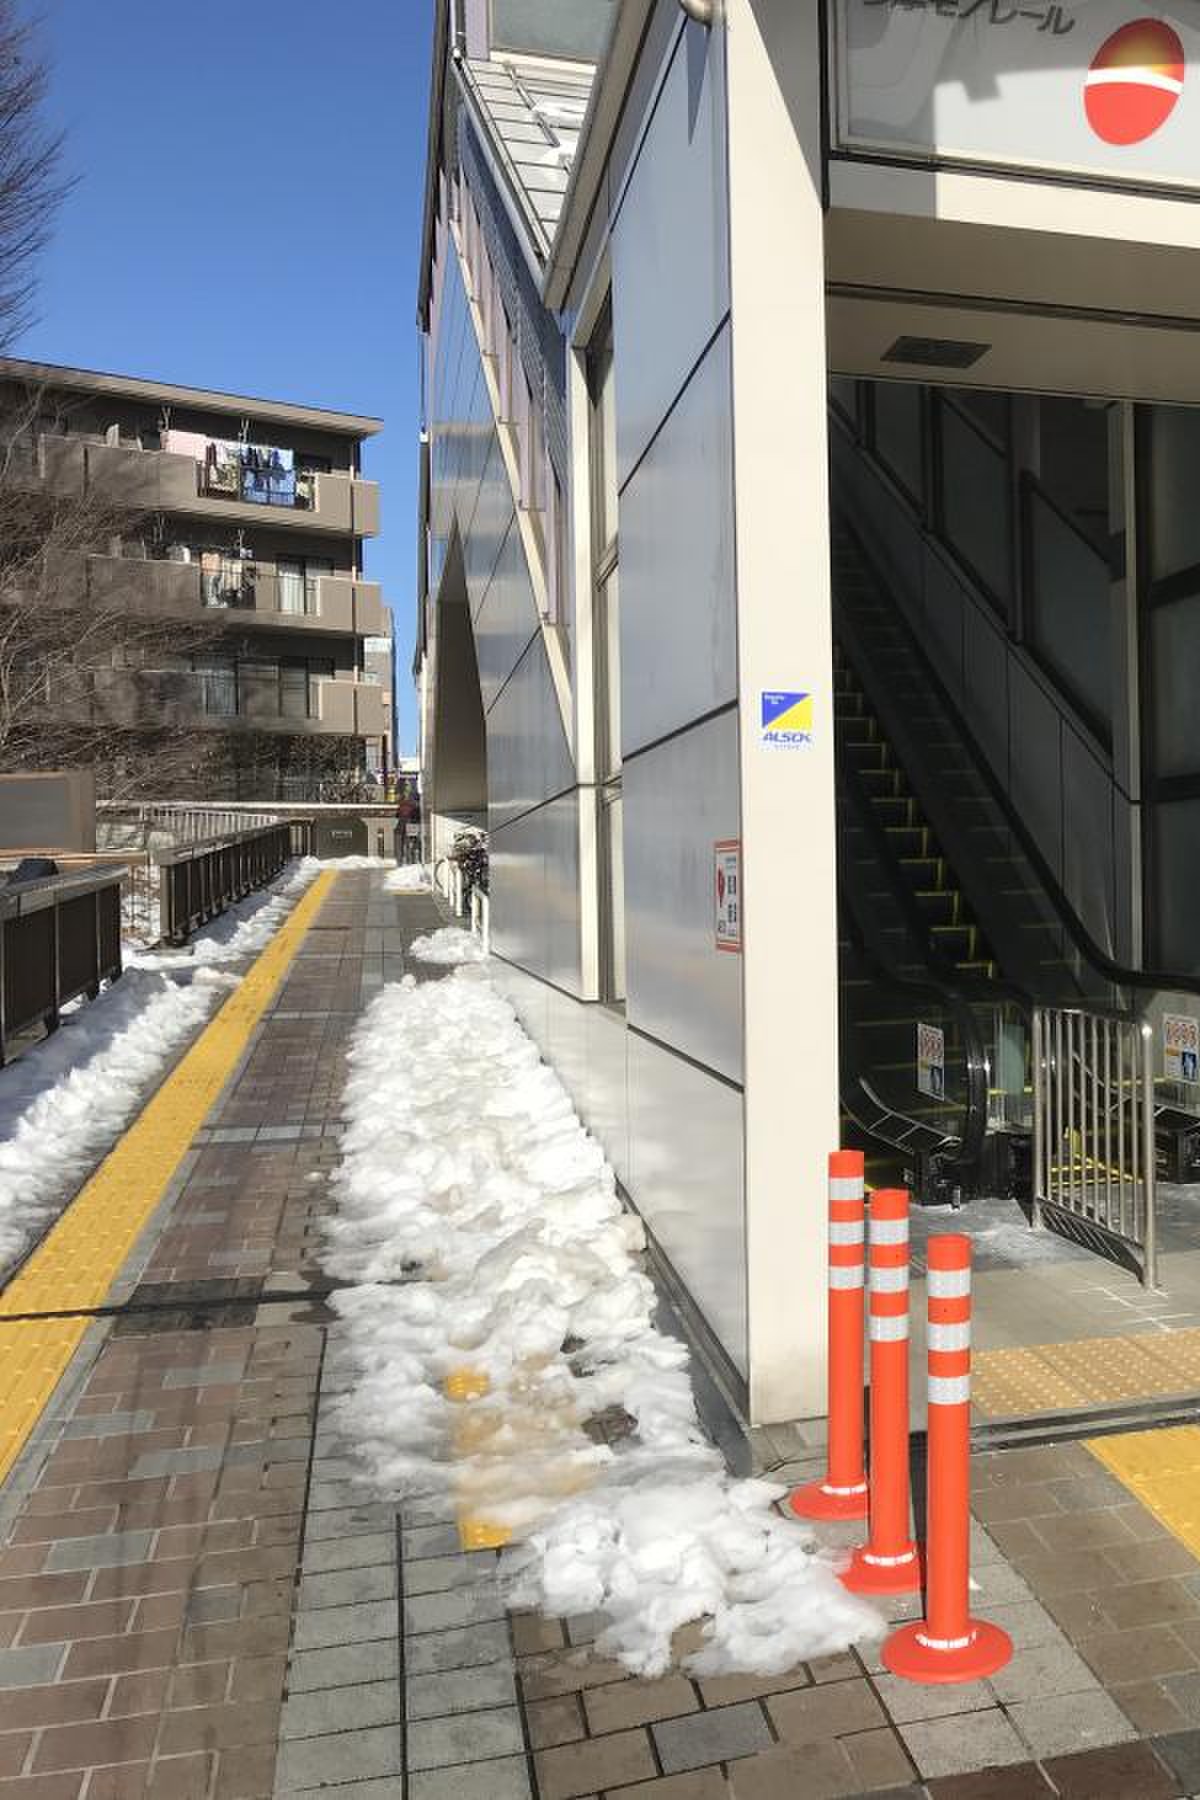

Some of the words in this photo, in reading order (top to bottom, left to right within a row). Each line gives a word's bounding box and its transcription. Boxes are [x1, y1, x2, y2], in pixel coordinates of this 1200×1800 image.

[864, 0, 1075, 34] モノレール
